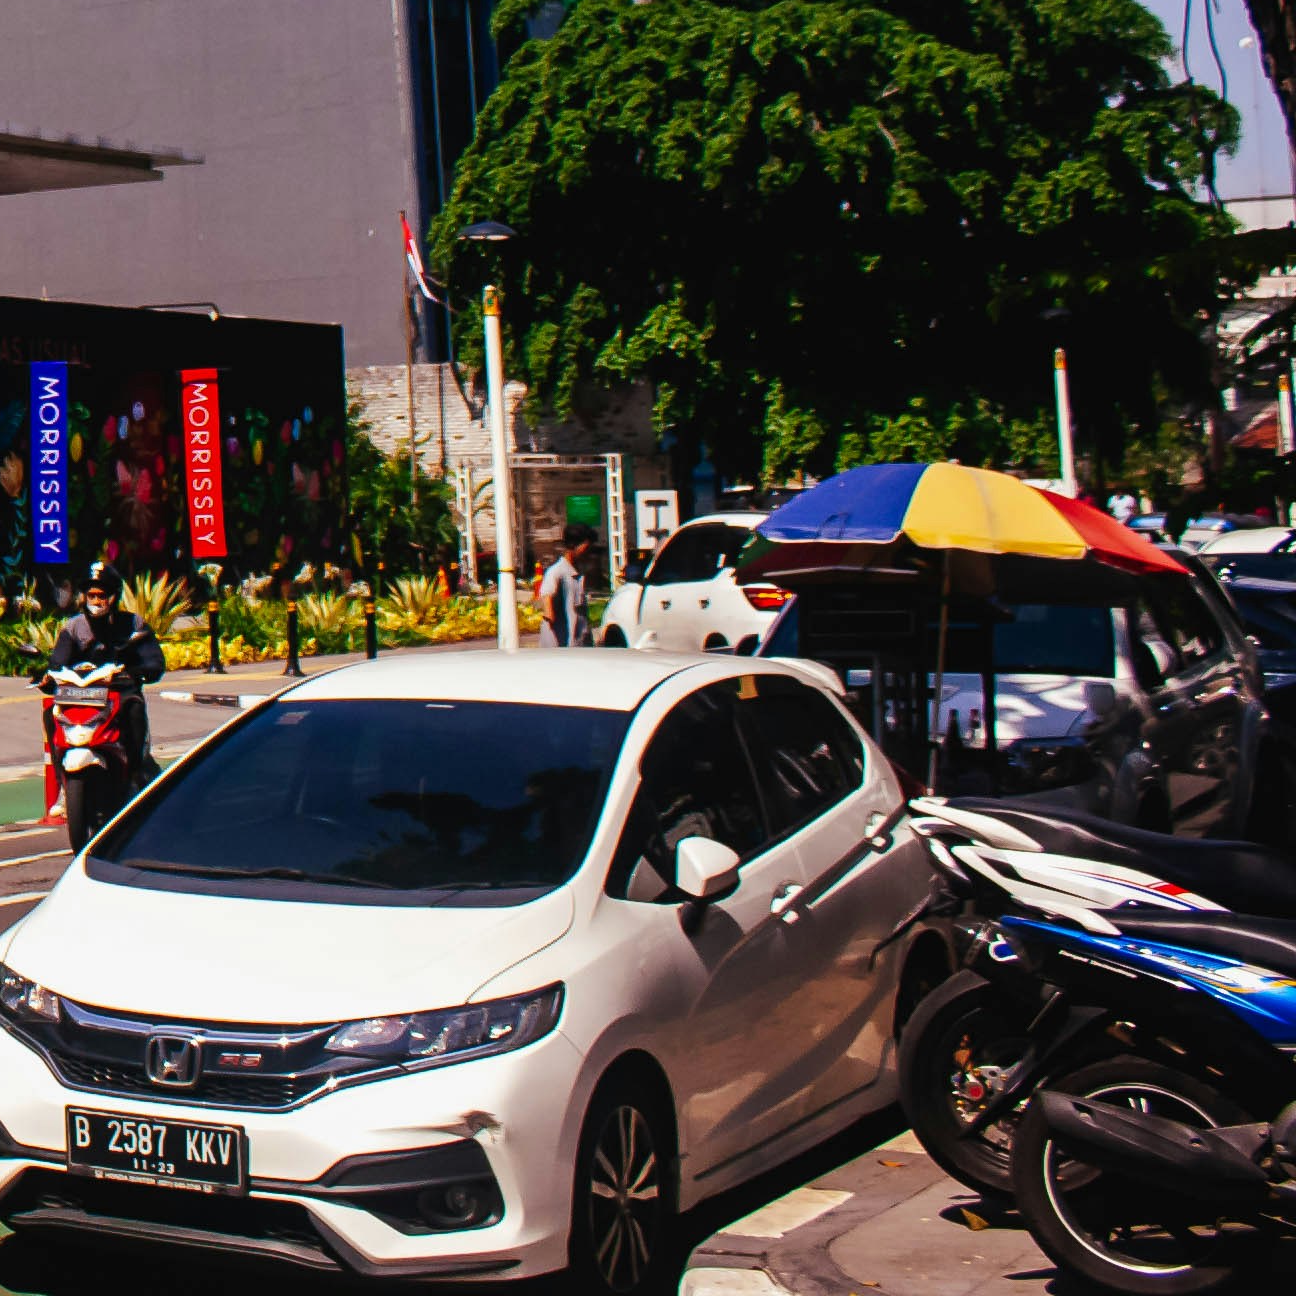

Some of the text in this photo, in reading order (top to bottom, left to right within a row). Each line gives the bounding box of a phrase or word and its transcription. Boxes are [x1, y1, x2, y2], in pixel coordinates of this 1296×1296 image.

[0, 335, 22, 363] AS
[38, 376, 61, 554] MORRISSEY
[188, 383, 216, 546] MORRISSEY
[218, 1053, 262, 1068] RS
[75, 1115, 231, 1165] B 2587 KKV
